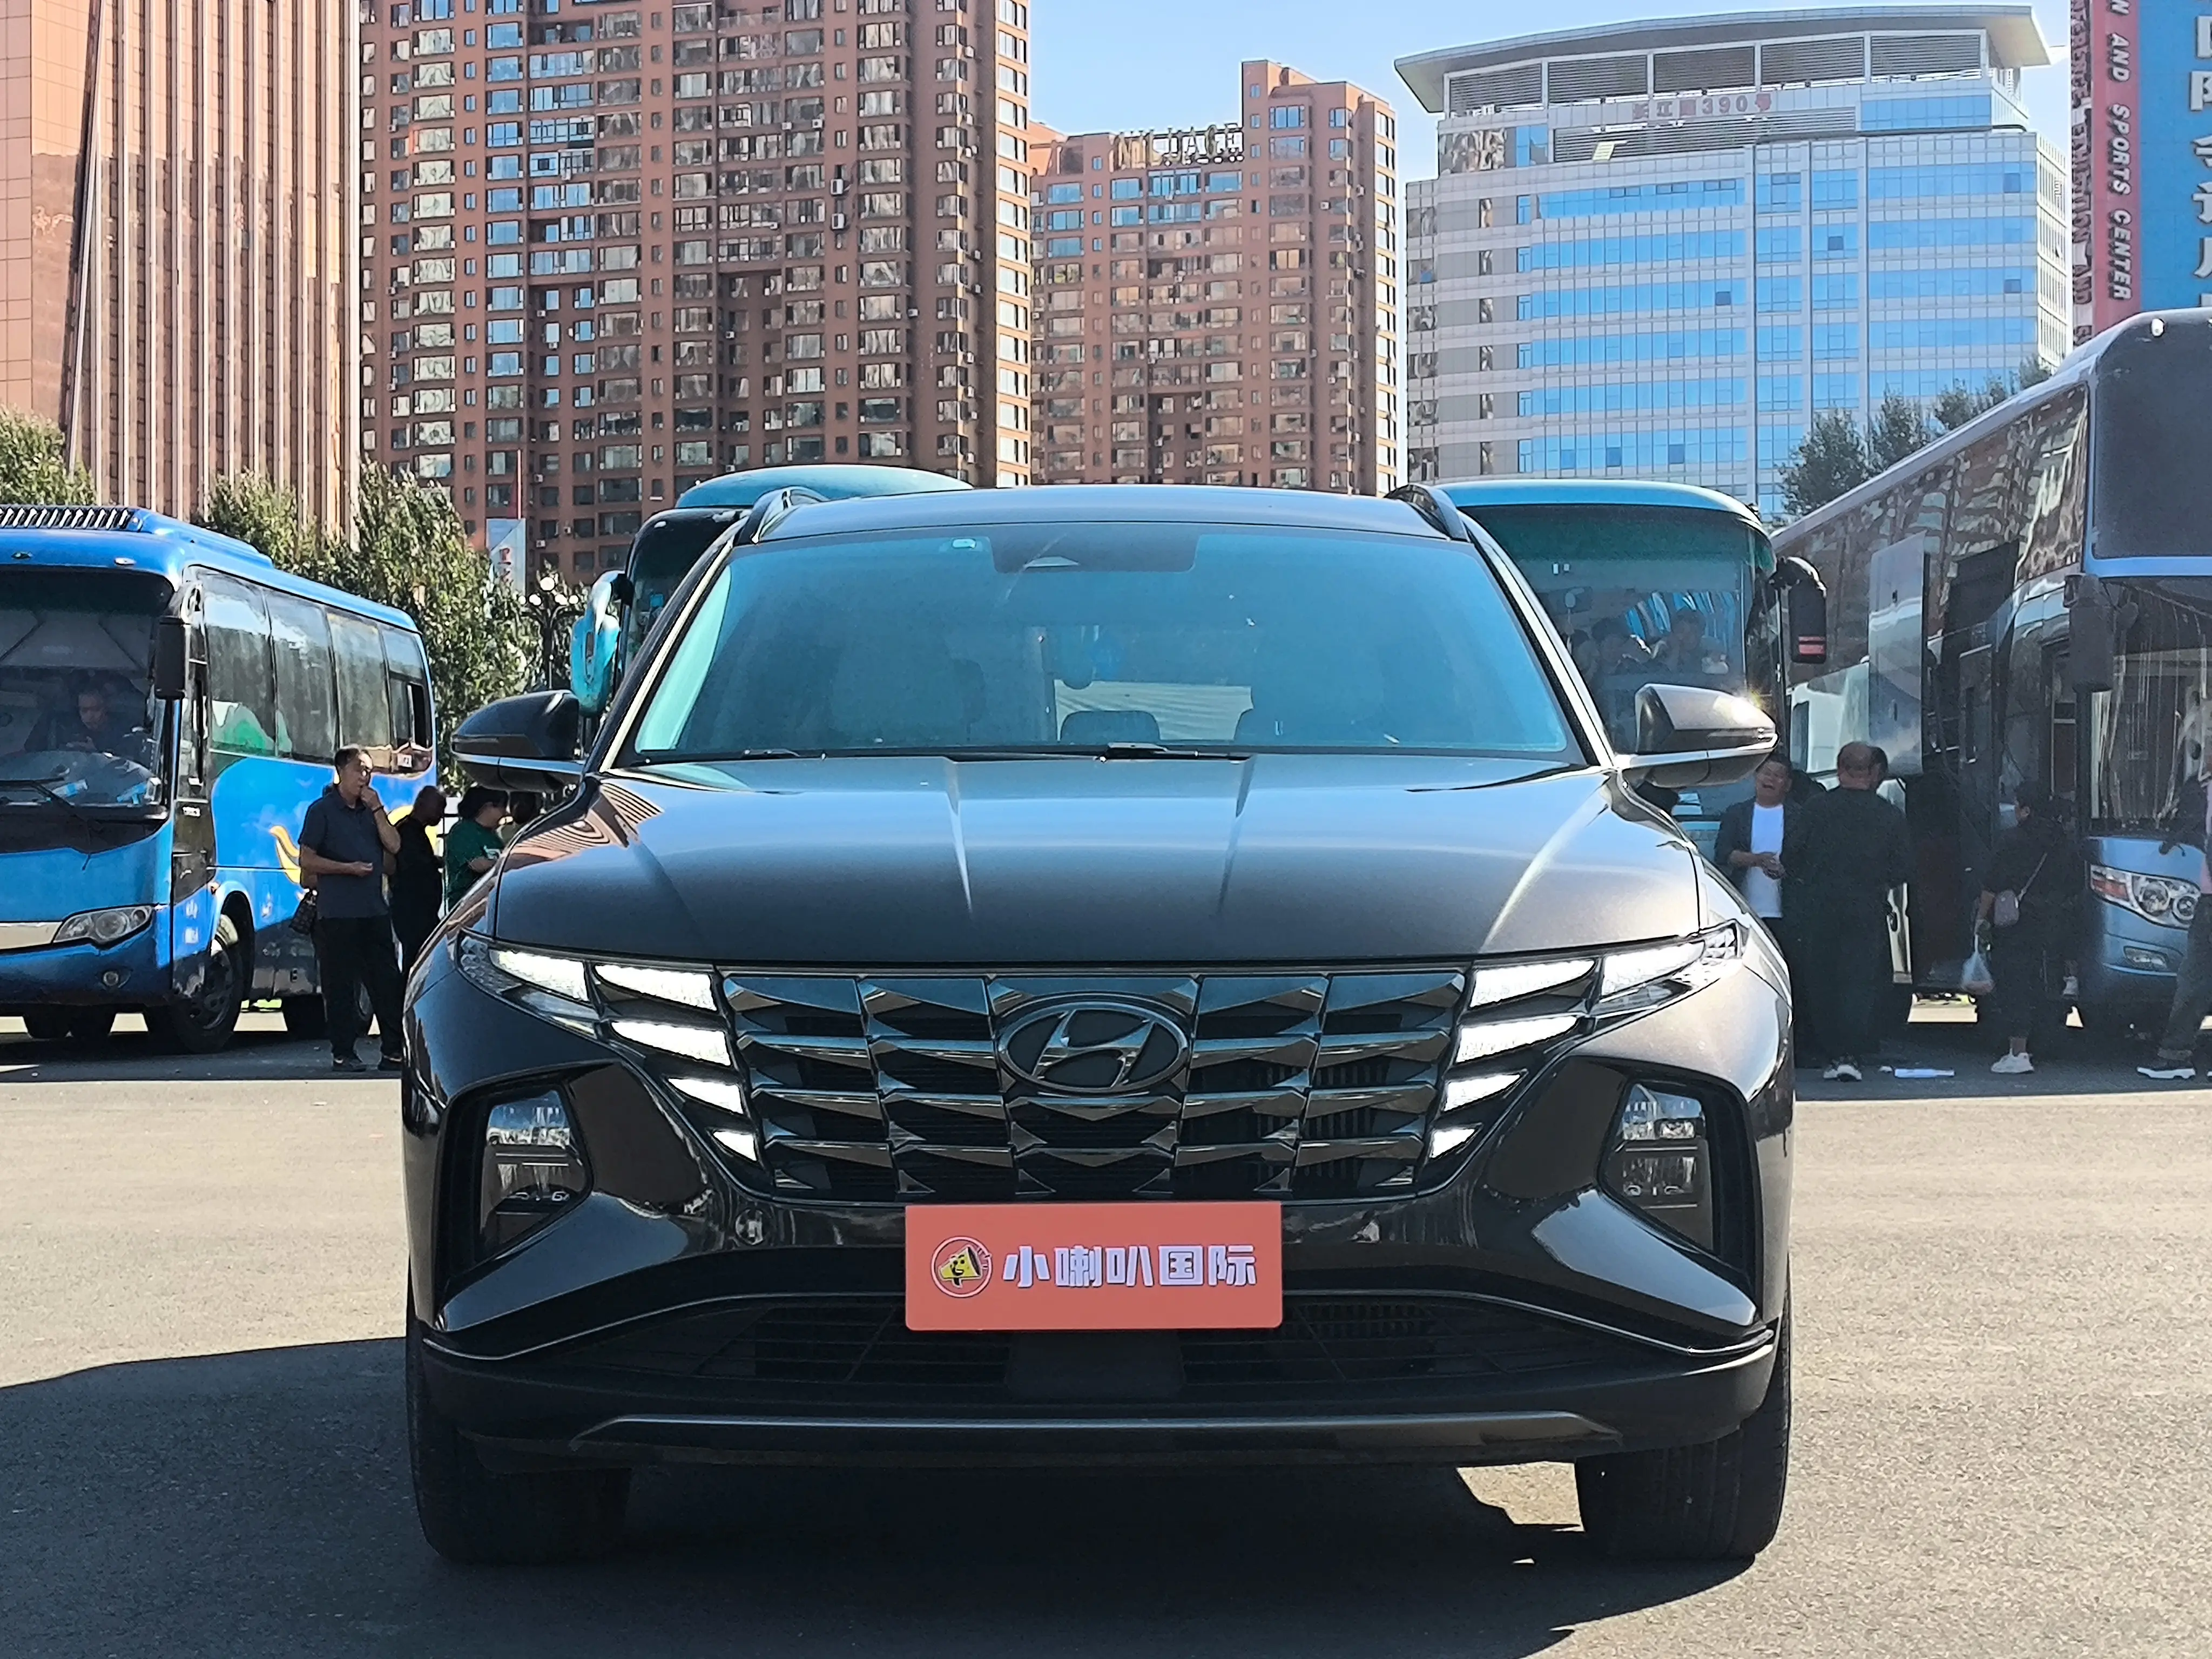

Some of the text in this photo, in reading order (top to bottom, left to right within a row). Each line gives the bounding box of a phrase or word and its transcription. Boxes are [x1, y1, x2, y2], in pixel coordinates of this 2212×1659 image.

[2111, 32, 2130, 82] AND
[2112, 103, 2131, 195] SPORTS
[2112, 209, 2132, 300] CENTER
[1003, 1245, 1256, 1288] 小喇叭国际
